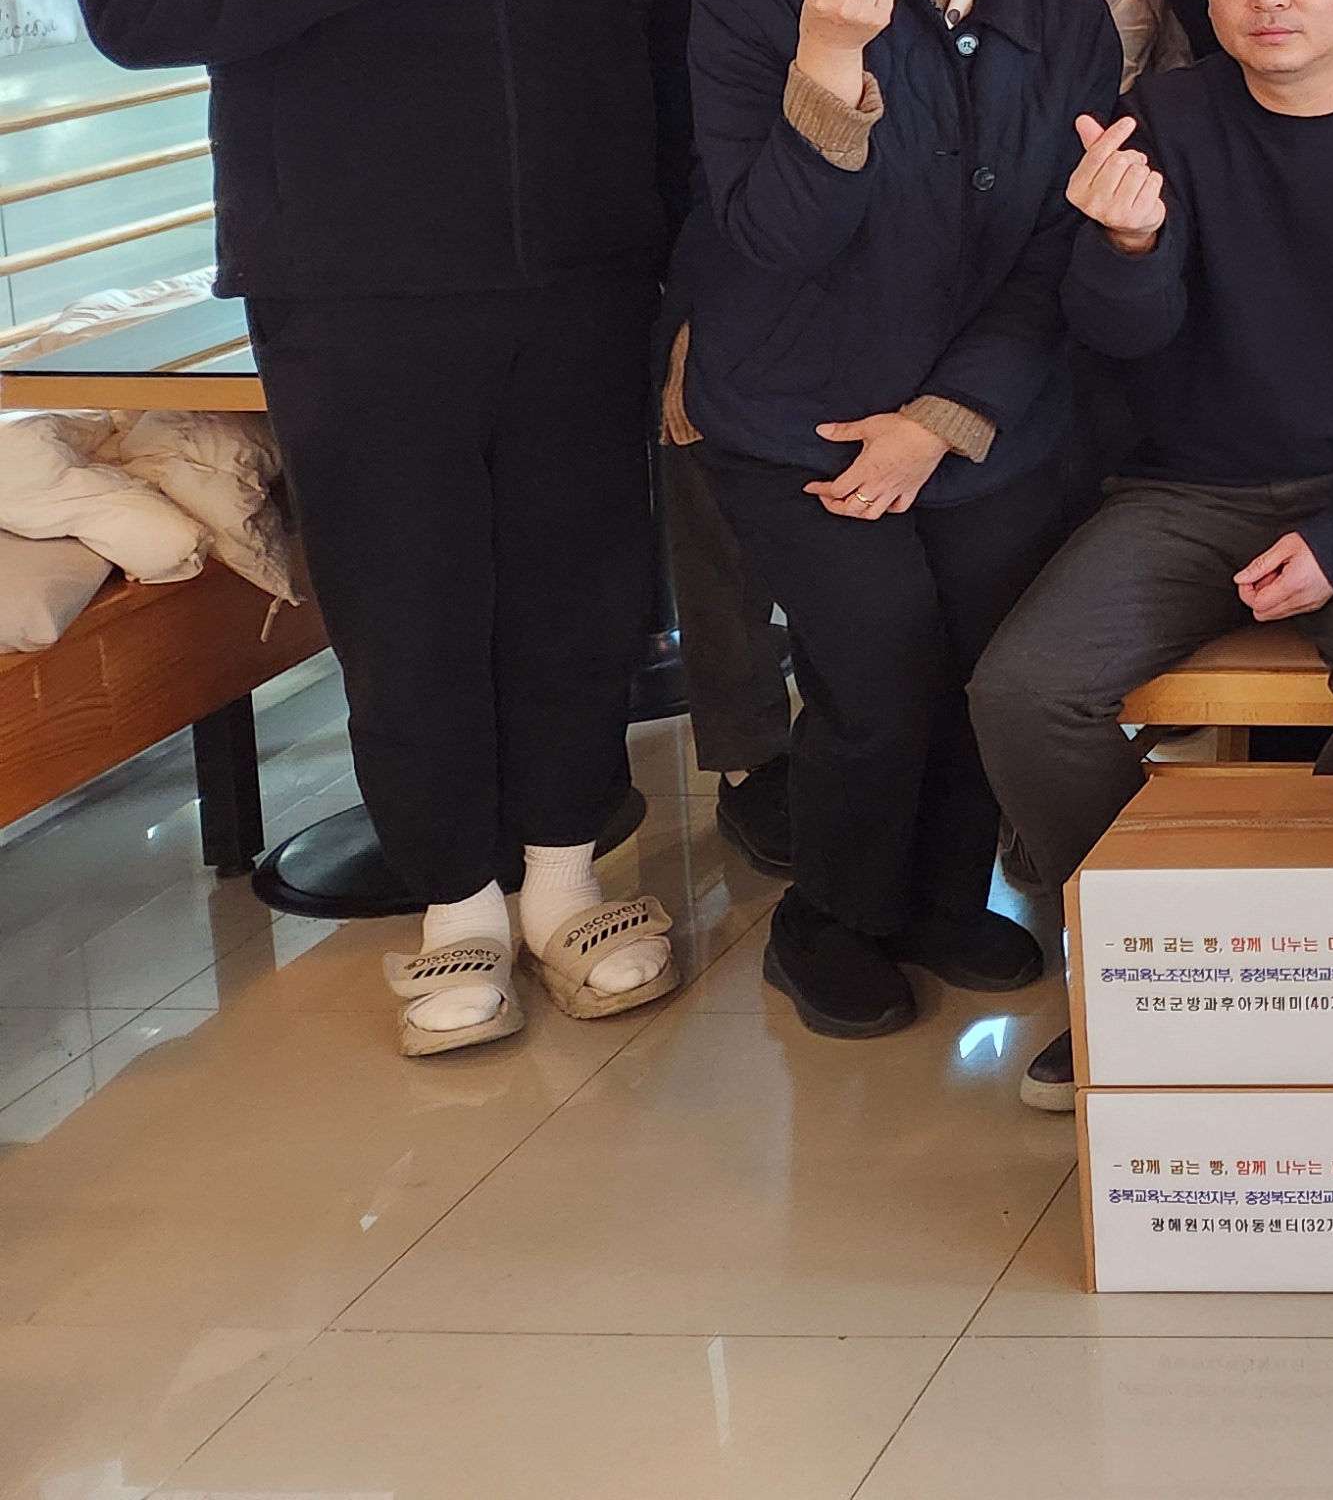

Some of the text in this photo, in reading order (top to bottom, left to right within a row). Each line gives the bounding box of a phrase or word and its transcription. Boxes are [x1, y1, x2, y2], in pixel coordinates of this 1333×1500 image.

[1123, 936, 1154, 953] 함께
[1163, 937, 1194, 953] 굽는
[1203, 936, 1223, 954] 빵,
[1230, 936, 1262, 953] 함께
[1271, 936, 1319, 953] 나누는
[1100, 967, 1234, 983] 충북교육노조진천지부,
[1130, 1158, 1161, 1175] 함께
[1169, 1159, 1201, 1176] 굽는
[1209, 1159, 1229, 1176] 빵,
[1235, 1160, 1267, 1176] 함께
[1276, 1160, 1323, 1176] 나누는
[1108, 1188, 1239, 1206] 충북교육노조진천지부,
